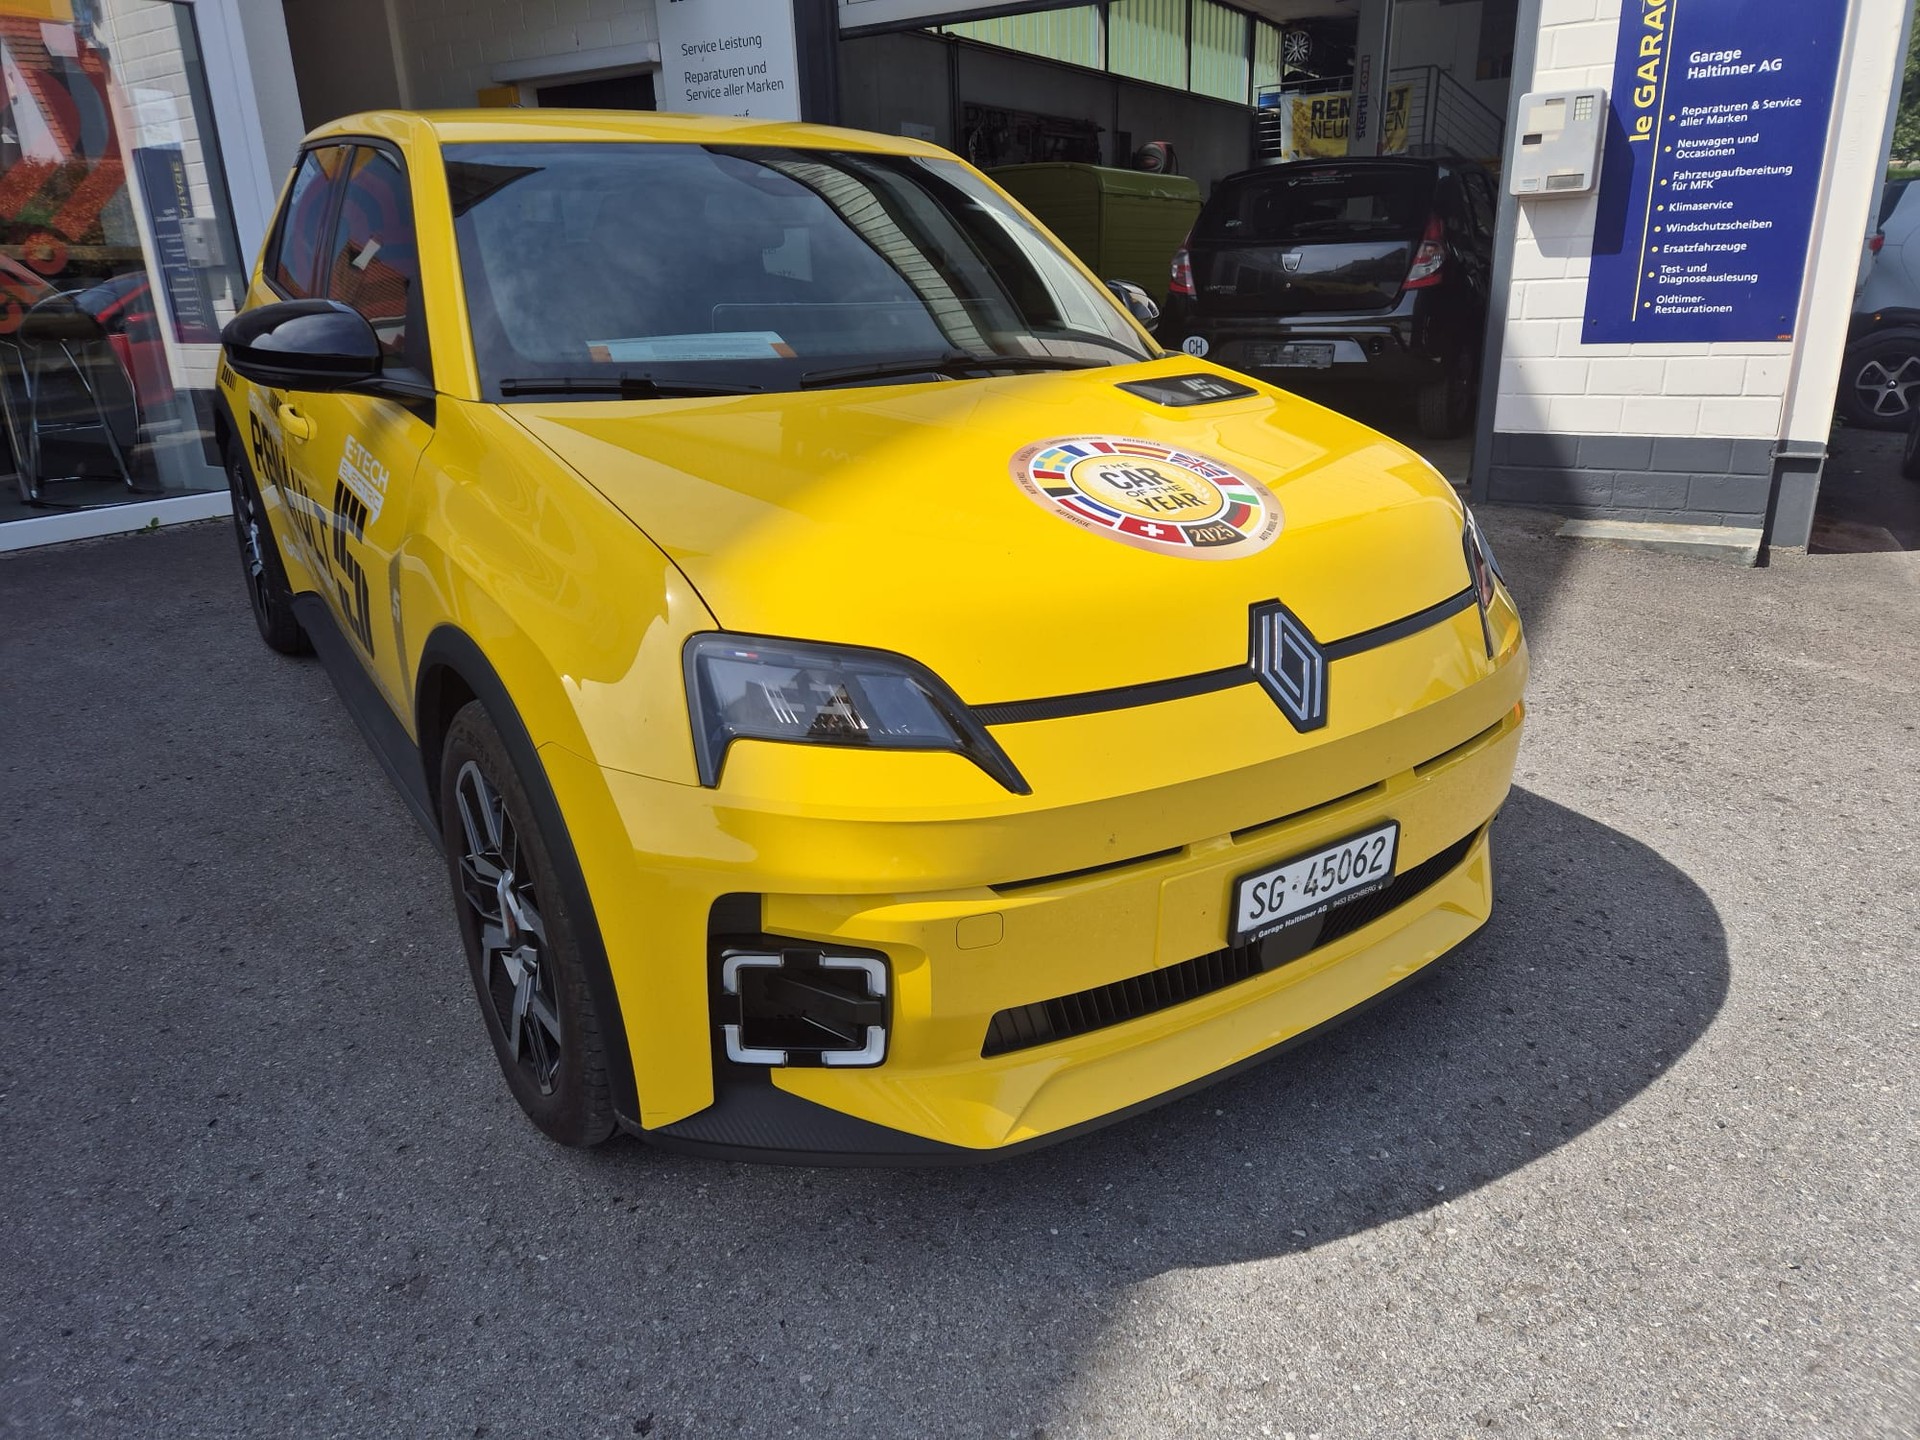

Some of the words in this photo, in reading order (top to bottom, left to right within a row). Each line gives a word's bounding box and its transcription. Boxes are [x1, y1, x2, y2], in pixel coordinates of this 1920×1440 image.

[681, 41, 717, 56] Service
[719, 34, 762, 51] Leistung
[1689, 48, 1742, 64] Garage
[684, 67, 745, 85] Reparaturen
[747, 61, 767, 76] und
[1687, 64, 1755, 80] Haltinner
[1758, 58, 1782, 73] AG
[686, 86, 721, 101] Service
[723, 84, 744, 97] aller
[746, 79, 784, 94] Marken
[1681, 101, 1748, 116] Reparaturen
[1751, 100, 1760, 110] &
[1762, 97, 1802, 109] Service
[1680, 116, 1703, 127] aller
[1706, 113, 1748, 125] Marken
[1629, 115, 1653, 142] le
[1677, 136, 1734, 149] Neuwagen
[1737, 133, 1759, 145] und
[1676, 147, 1735, 159] Occasionen
[1673, 165, 1793, 181] Fahrzeugaufbereitung
[1671, 180, 1688, 191] für
[1689, 180, 1714, 190] MFK
[1668, 201, 1733, 212] Klimaservice
[1666, 220, 1772, 233] Windschutzscheiben
[1663, 242, 1747, 254] Ersatzfahrzeuge
[1660, 264, 1684, 274] Test-
[1687, 263, 1708, 273] und
[1659, 272, 1758, 285] Diagnoseauslesung
[1656, 294, 1705, 304] Oldtimer-
[1654, 304, 1733, 314] Restaurationen
[1188, 339, 1204, 355] CH
[1100, 461, 1131, 470] THE
[1100, 467, 1176, 490] CAR
[1126, 489, 1147, 498] OF
[1151, 484, 1186, 494] THE
[1137, 493, 1208, 512] YEAR
[1189, 525, 1236, 543] 2025
[1250, 874, 1286, 920] SG
[1303, 835, 1386, 897] 45062
[1258, 923, 1284, 938] Garage
[1285, 909, 1317, 928] Haltinner
[1317, 905, 1328, 915] AG
